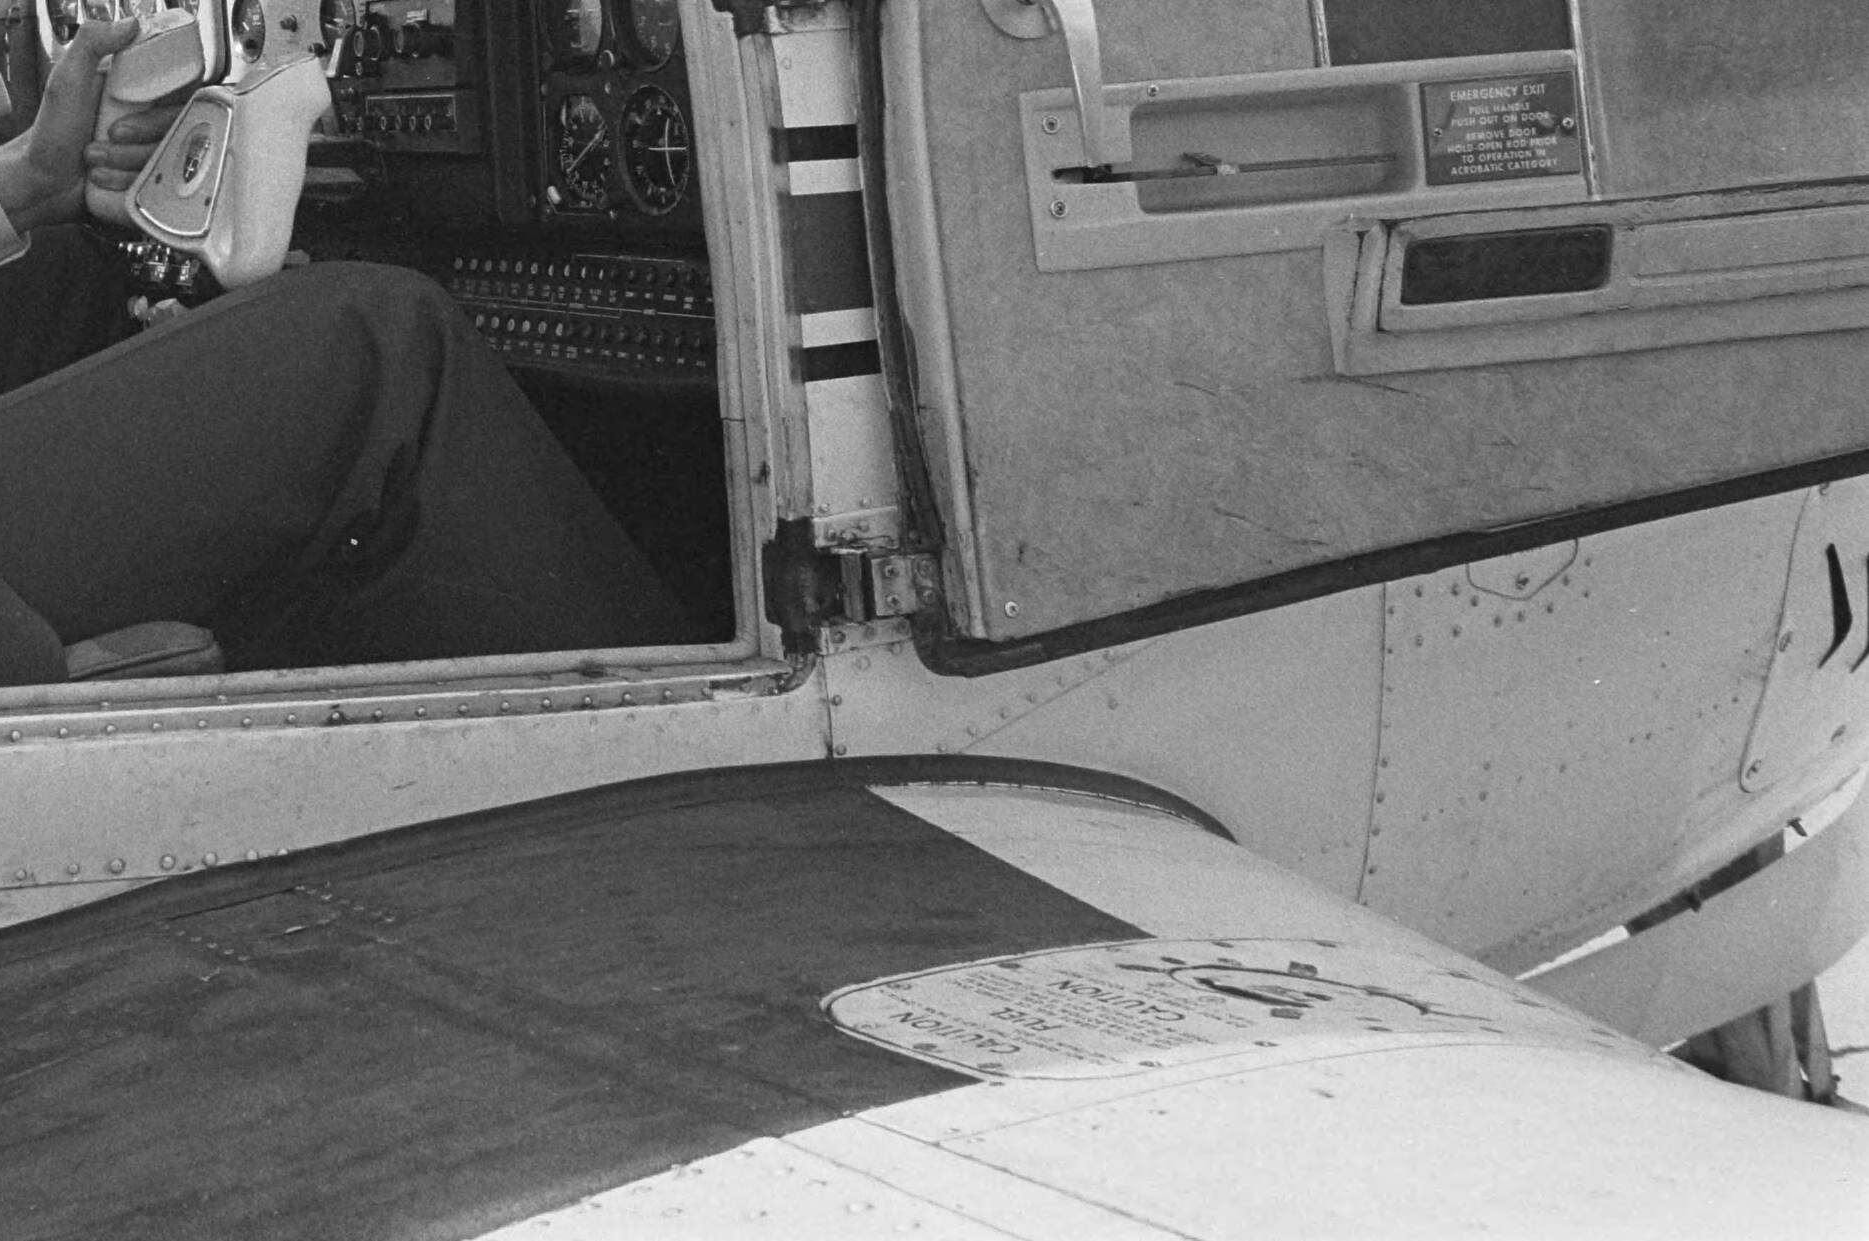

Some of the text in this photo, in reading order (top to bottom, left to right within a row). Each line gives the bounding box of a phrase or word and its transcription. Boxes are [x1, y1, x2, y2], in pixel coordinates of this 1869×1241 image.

[1450, 83, 1546, 102] EMERGENCY EXIT
[1469, 102, 1530, 115] PULL HANDLE
[1451, 111, 1550, 127] PUSH OUT ON DOOR
[1466, 127, 1537, 142] REMOVE DOOR
[1447, 136, 1558, 154] HOLD-OPEN ROD PRIOR
[1462, 149, 1546, 163] TO OPERATION IN
[1451, 158, 1558, 176] ACROBATIC CATEGORY
[1046, 980, 1186, 1022] CAUTION
[990, 1007, 1066, 1031] FUEL
[889, 1012, 1021, 1054] CAUTION
